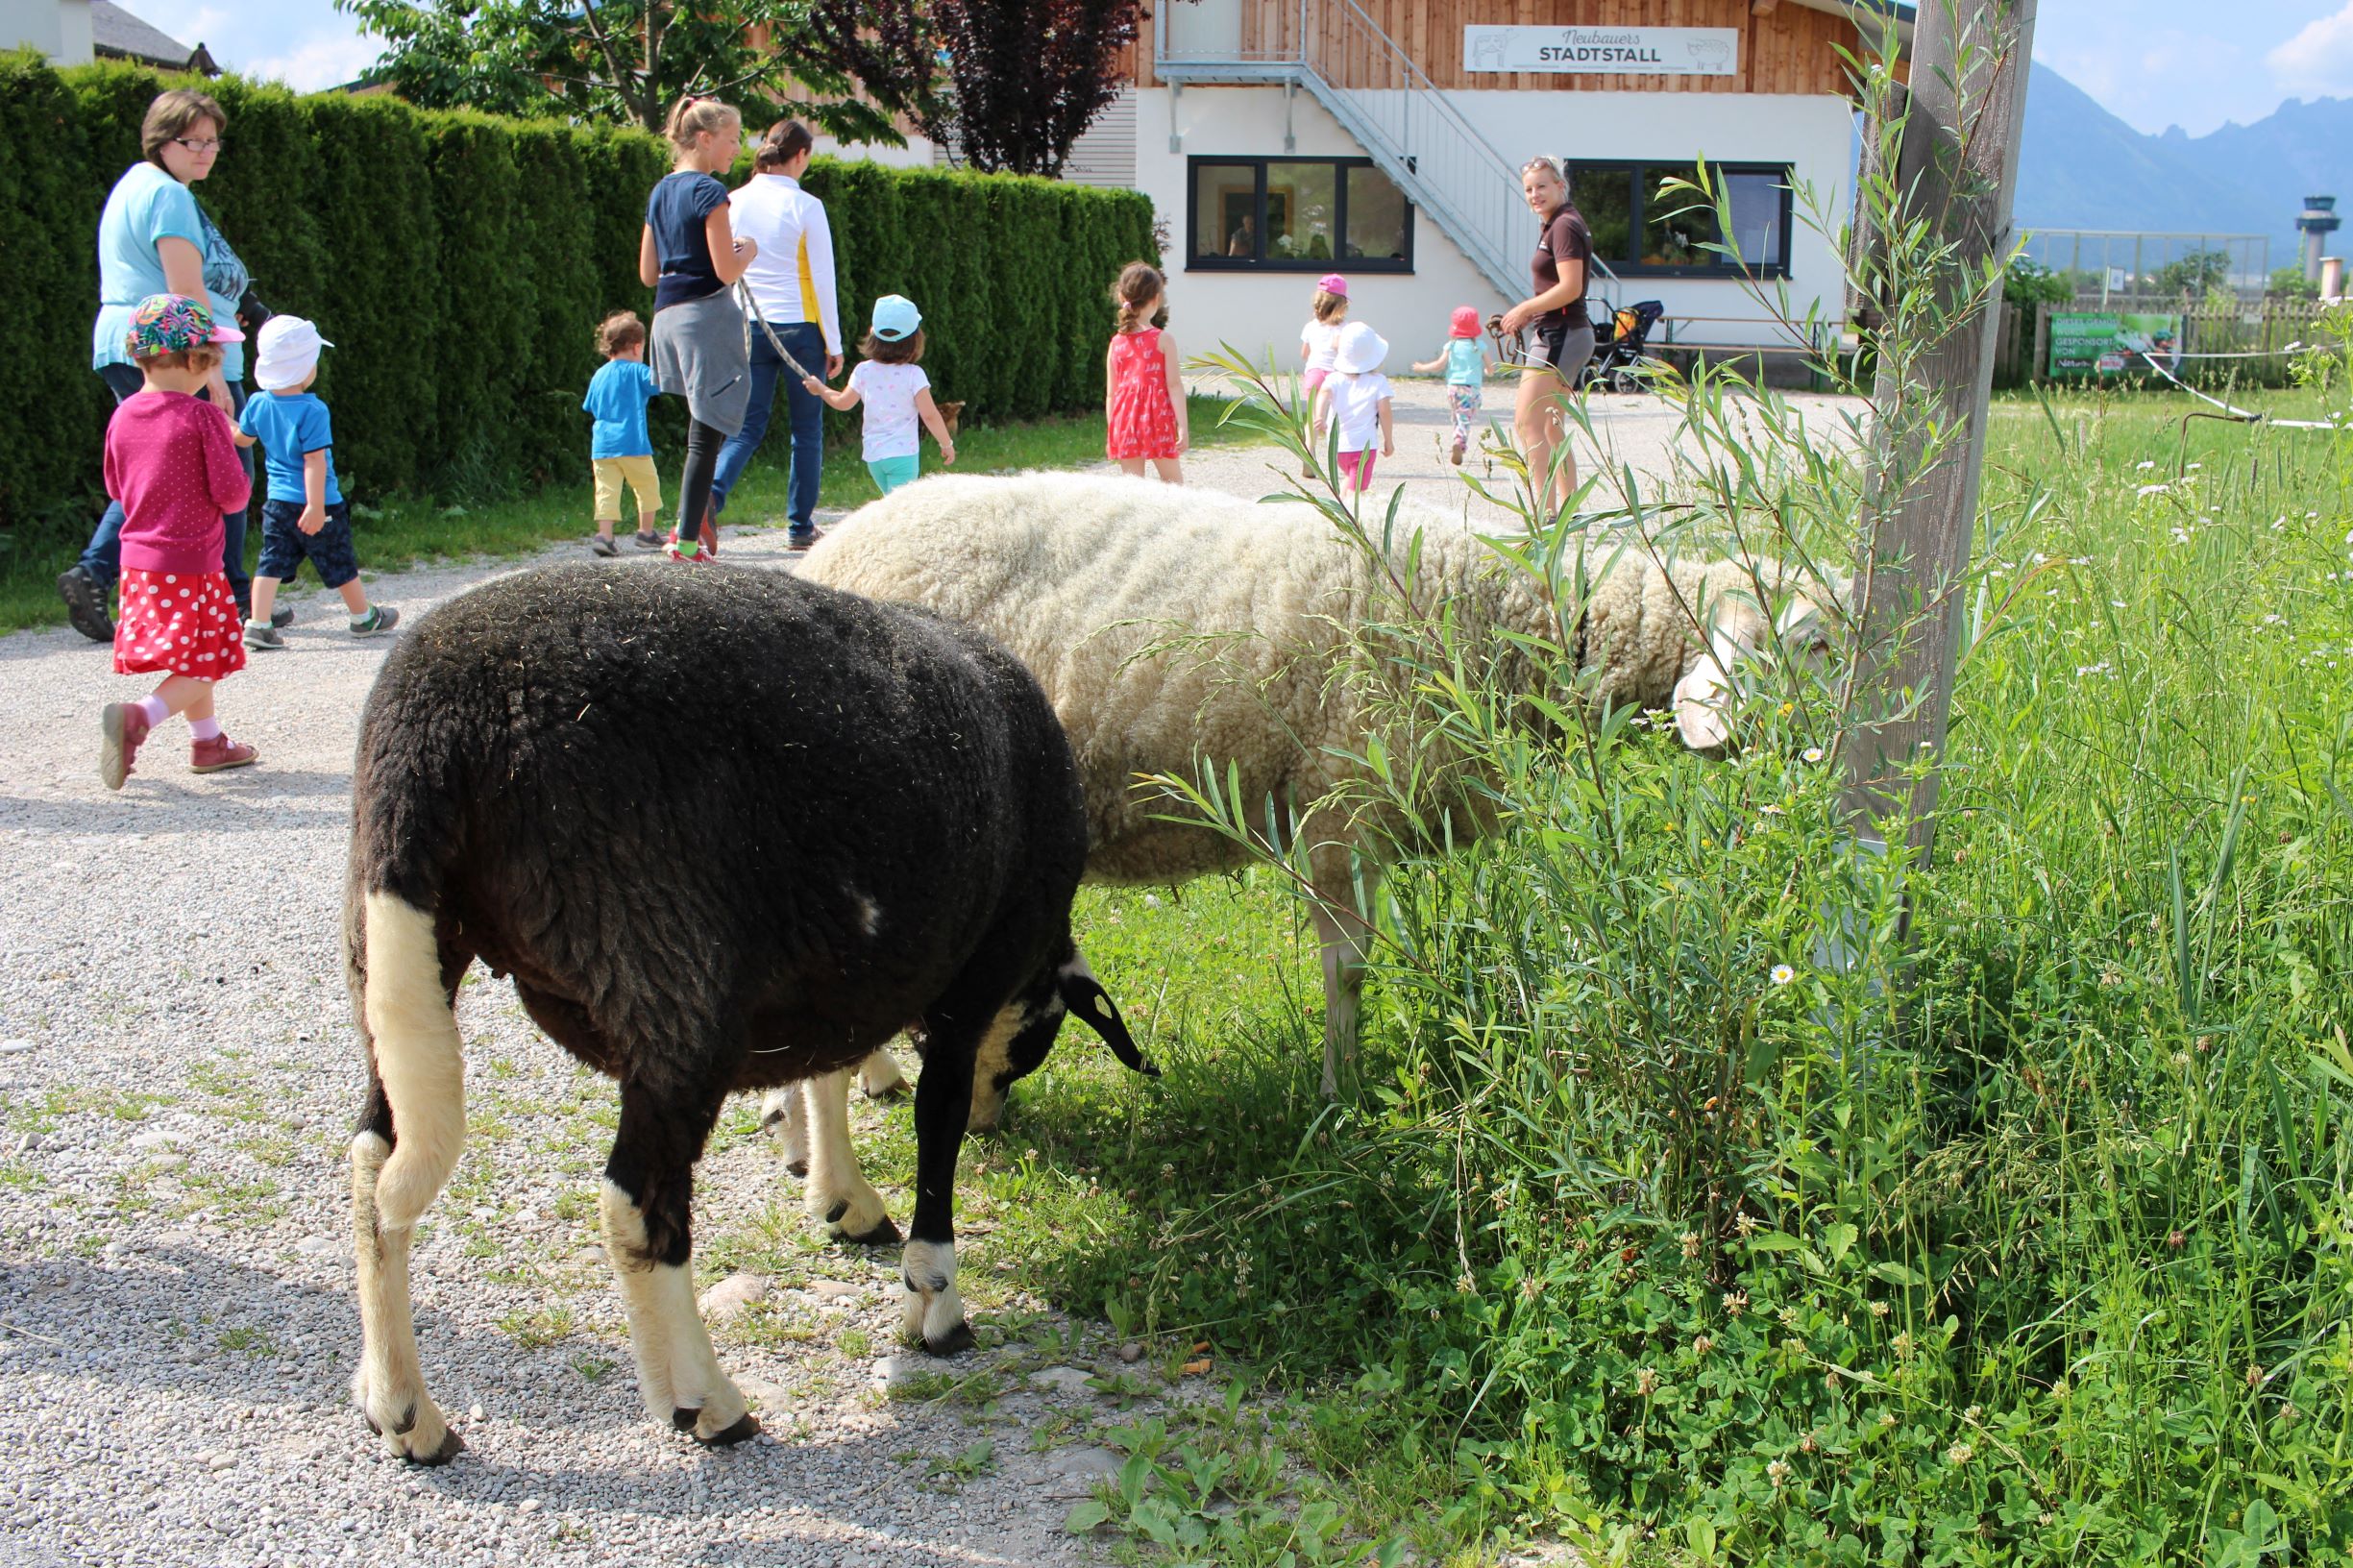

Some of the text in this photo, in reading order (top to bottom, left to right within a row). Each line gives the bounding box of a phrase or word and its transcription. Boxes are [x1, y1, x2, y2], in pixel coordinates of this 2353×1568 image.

[1562, 29, 1640, 44] Neubauers
[1539, 46, 1661, 61] STADTSTALL
[2055, 337, 2113, 347] GESPONSORT
